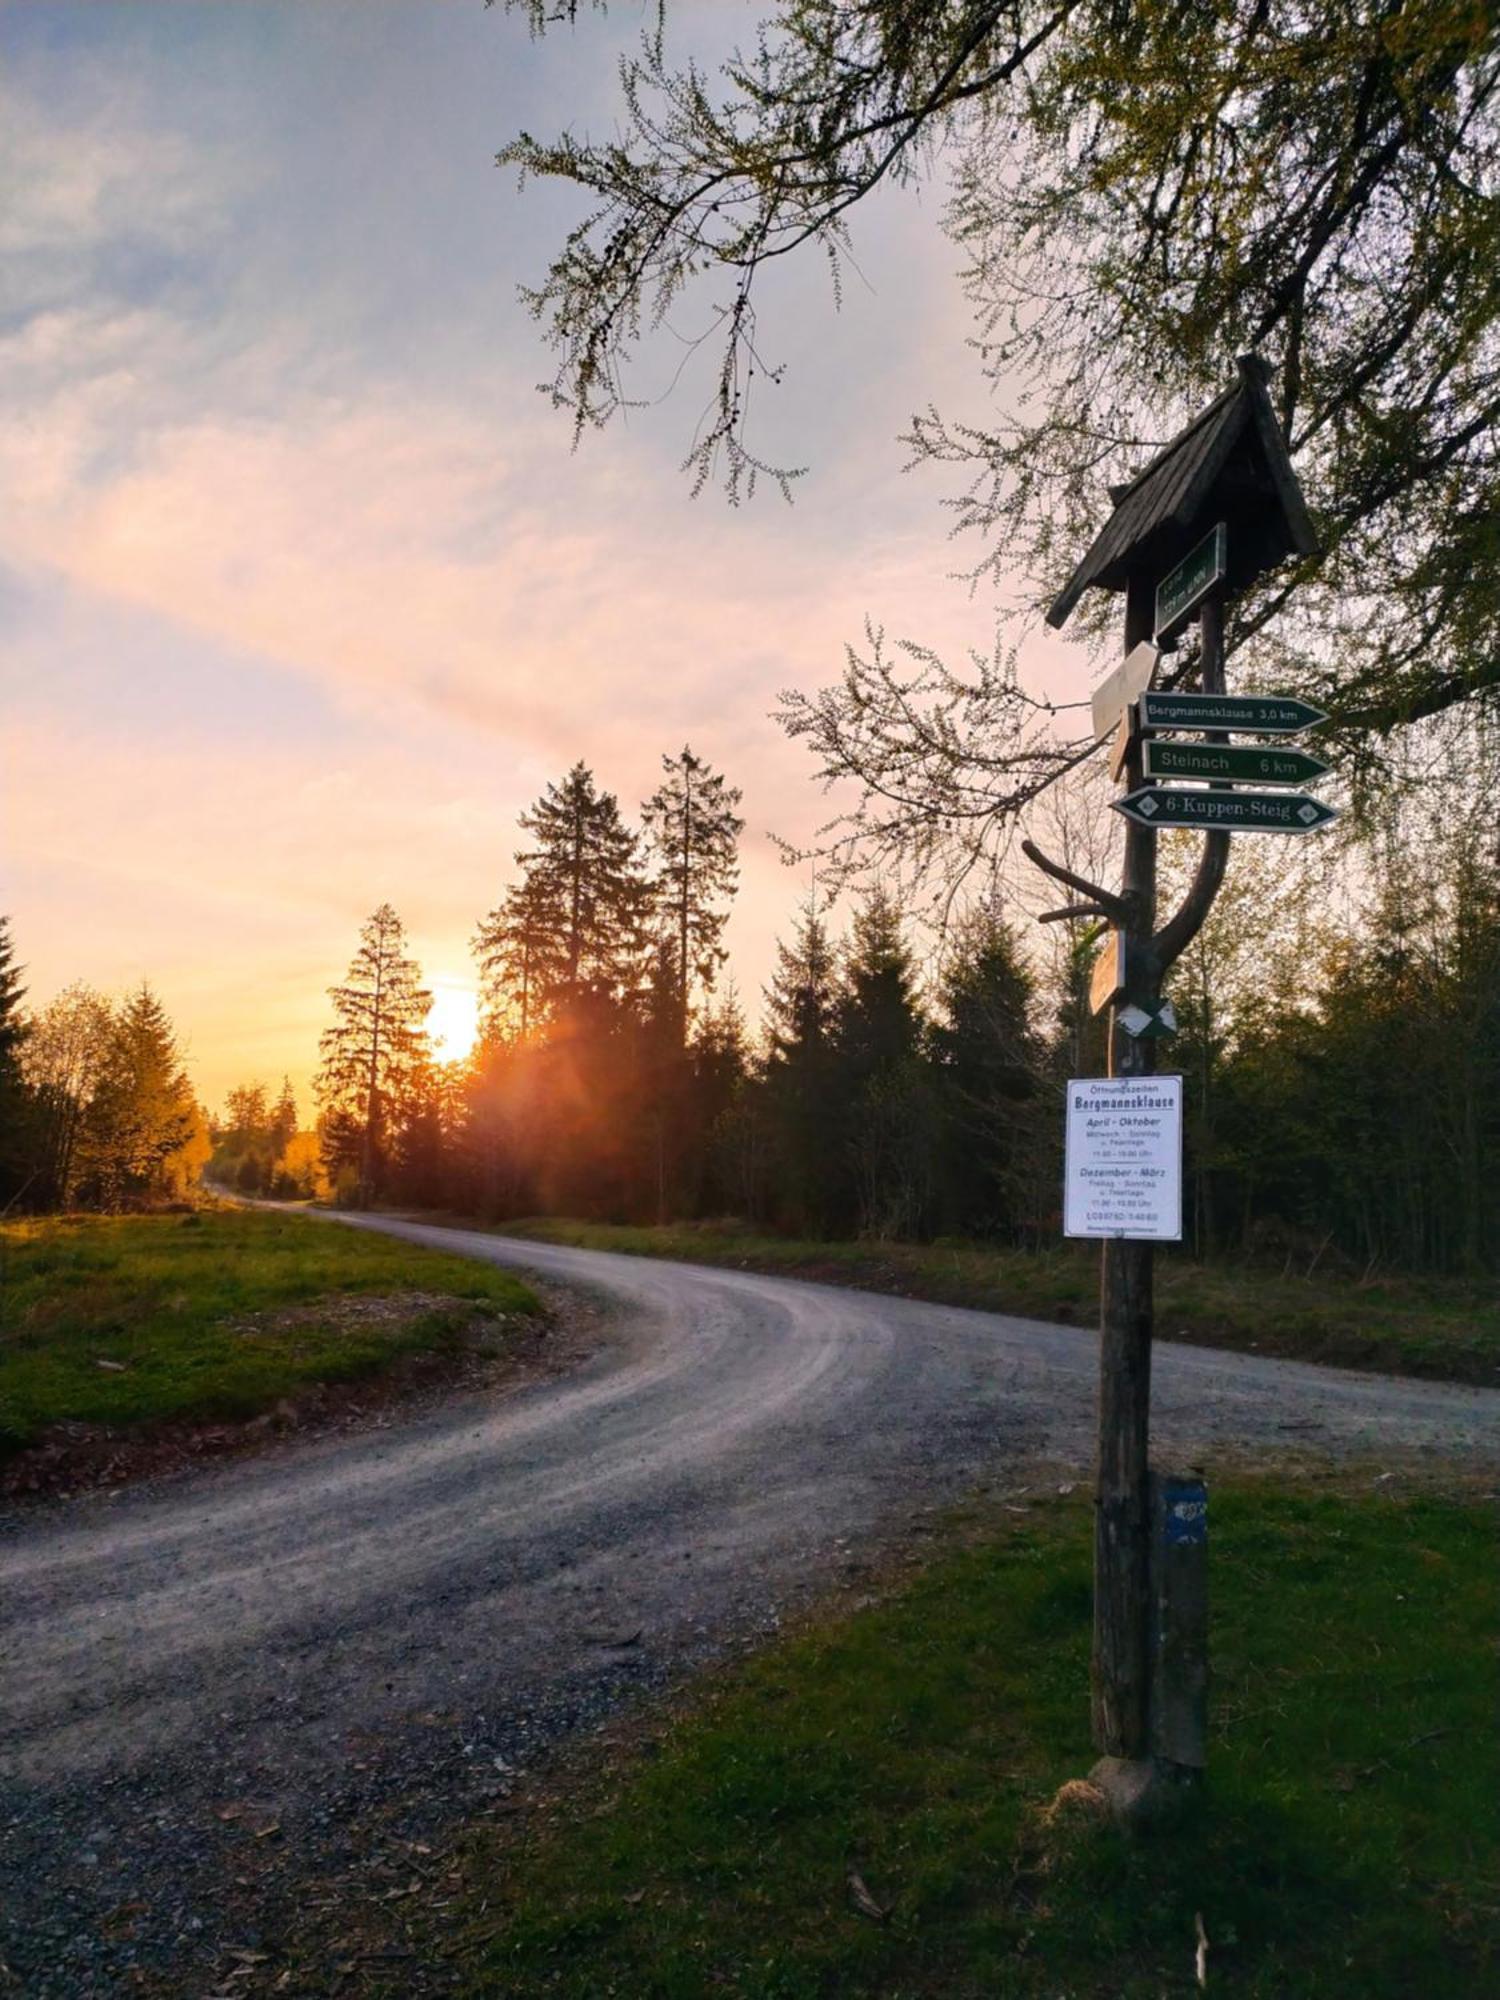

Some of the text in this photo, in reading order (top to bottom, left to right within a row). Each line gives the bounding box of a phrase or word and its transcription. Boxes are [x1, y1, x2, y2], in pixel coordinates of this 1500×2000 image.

[1148, 704, 1298, 721] Bergmannsklause 3,0 km
[1161, 752, 1298, 774] Steinach 6 km
[1166, 796, 1291, 820] 6-Kuppen-Steig
[1075, 1095, 1174, 1112] Bergmannsklause
[1086, 1117, 1111, 1130] April
[1119, 1117, 1162, 1128] Oktober
[1080, 1167, 1132, 1177] Dezember
[1139, 1167, 1166, 1178] März
